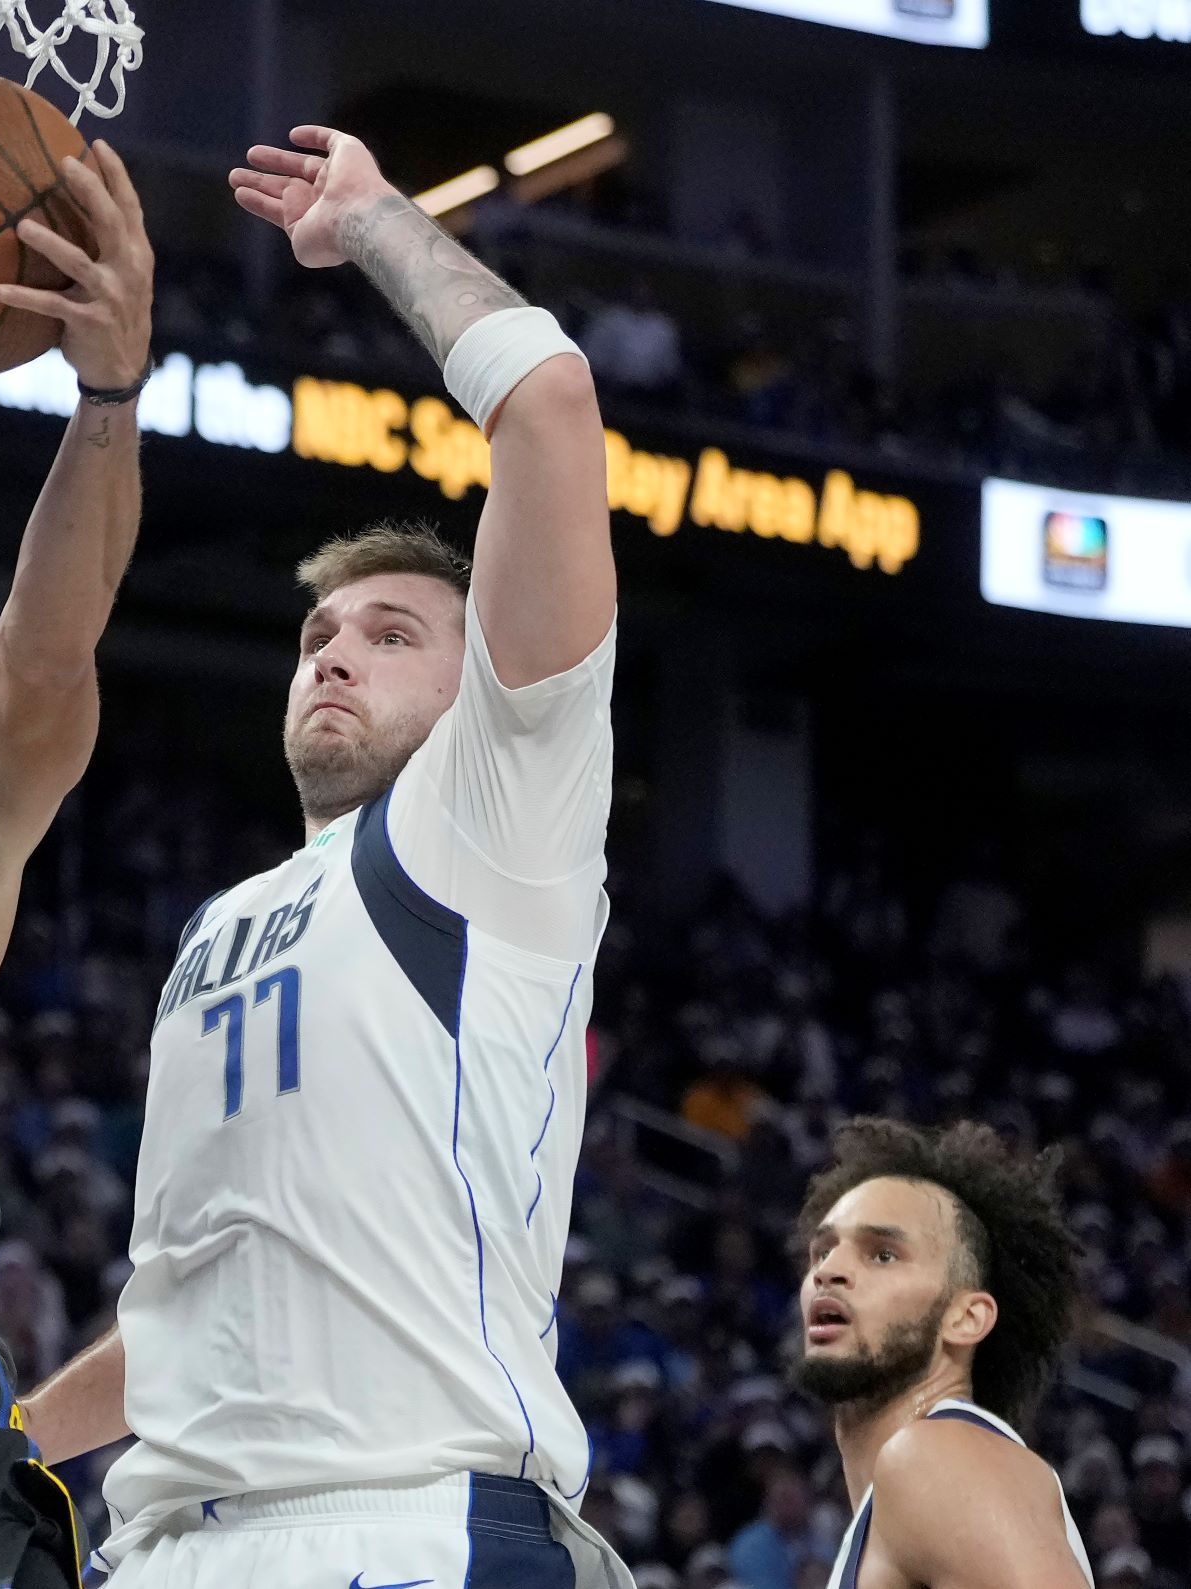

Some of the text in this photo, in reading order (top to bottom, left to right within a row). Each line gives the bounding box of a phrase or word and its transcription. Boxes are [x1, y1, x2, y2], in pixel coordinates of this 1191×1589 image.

[194, 362, 292, 453] the
[294, 377, 408, 471] NBC
[691, 447, 814, 544] Area
[818, 469, 919, 575] App
[201, 965, 302, 1122] 77
